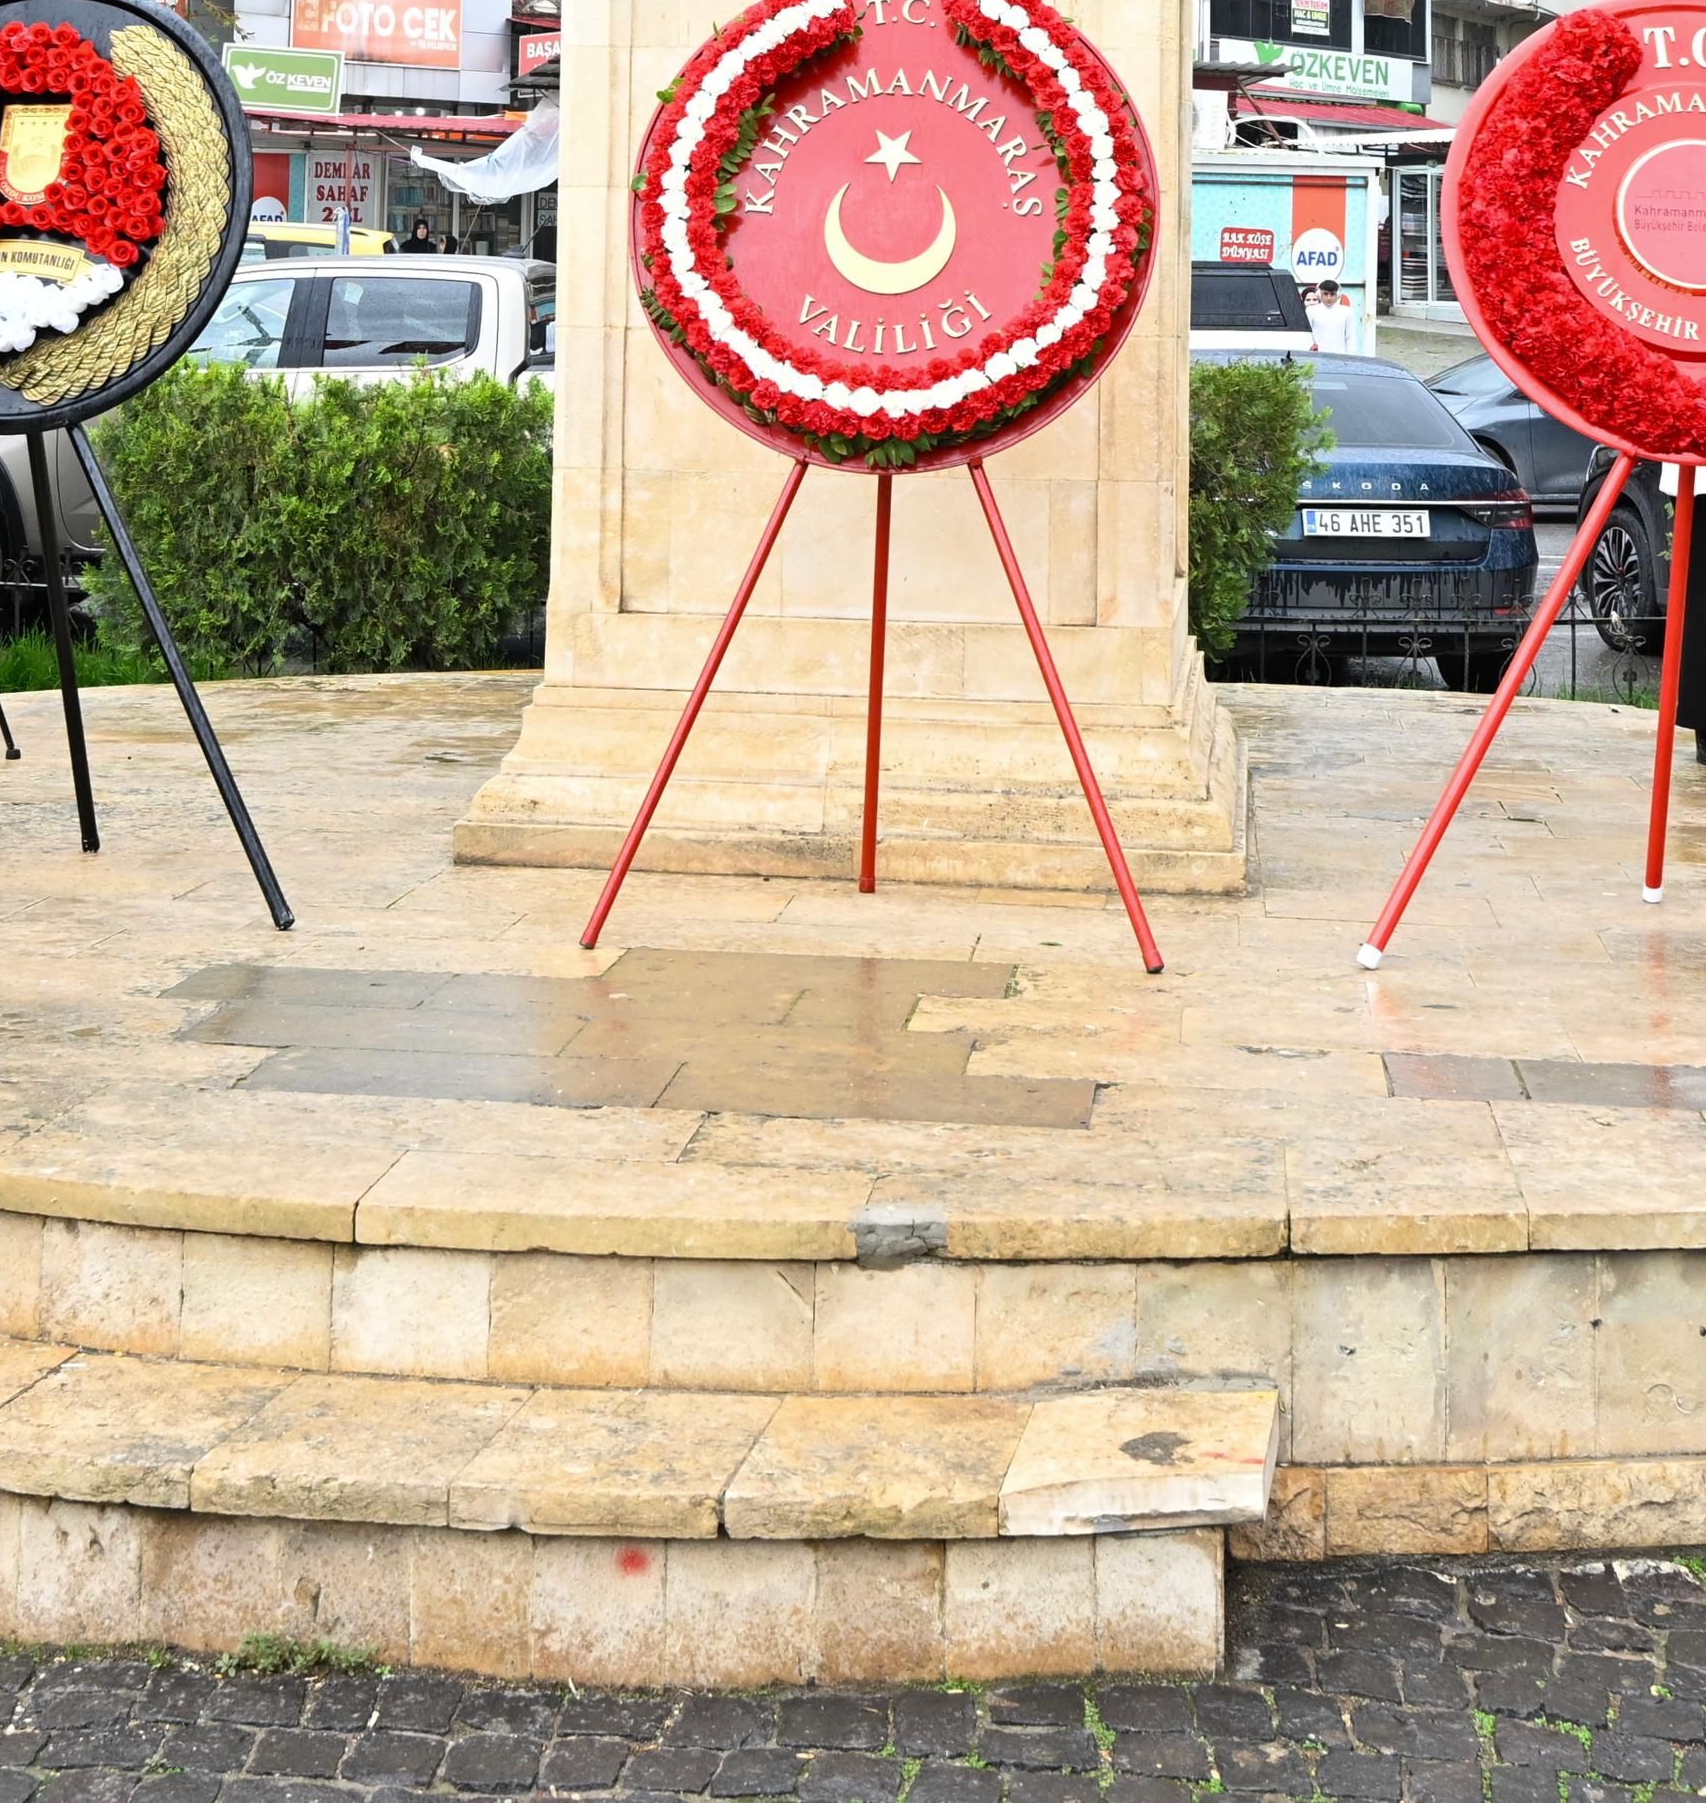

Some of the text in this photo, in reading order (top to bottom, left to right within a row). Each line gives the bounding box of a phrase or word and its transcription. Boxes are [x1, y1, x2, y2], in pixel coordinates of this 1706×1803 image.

[526, 40, 561, 60] BAŞA
[1290, 51, 1388, 86] ÖZKEVEN
[266, 72, 332, 88] ÖZ KEVEN
[744, 67, 1043, 218] KAHRAMANMARAŞ
[314, 162, 371, 180] DEMAR
[316, 185, 369, 202] SAHAF
[1222, 232, 1273, 245] BAK KÖŞE
[11, 251, 75, 271] KOMUTANLIĞI
[1221, 245, 1269, 260] DÜNYASI
[1296, 251, 1338, 266] AFAD
[1569, 236, 1700, 342] BÜYÜKŞEHİR
[797, 290, 994, 355] VALİLİĞİ
[1319, 513, 1341, 532] 46
[1350, 513, 1383, 533] AHE
[1391, 514, 1424, 534] 351
